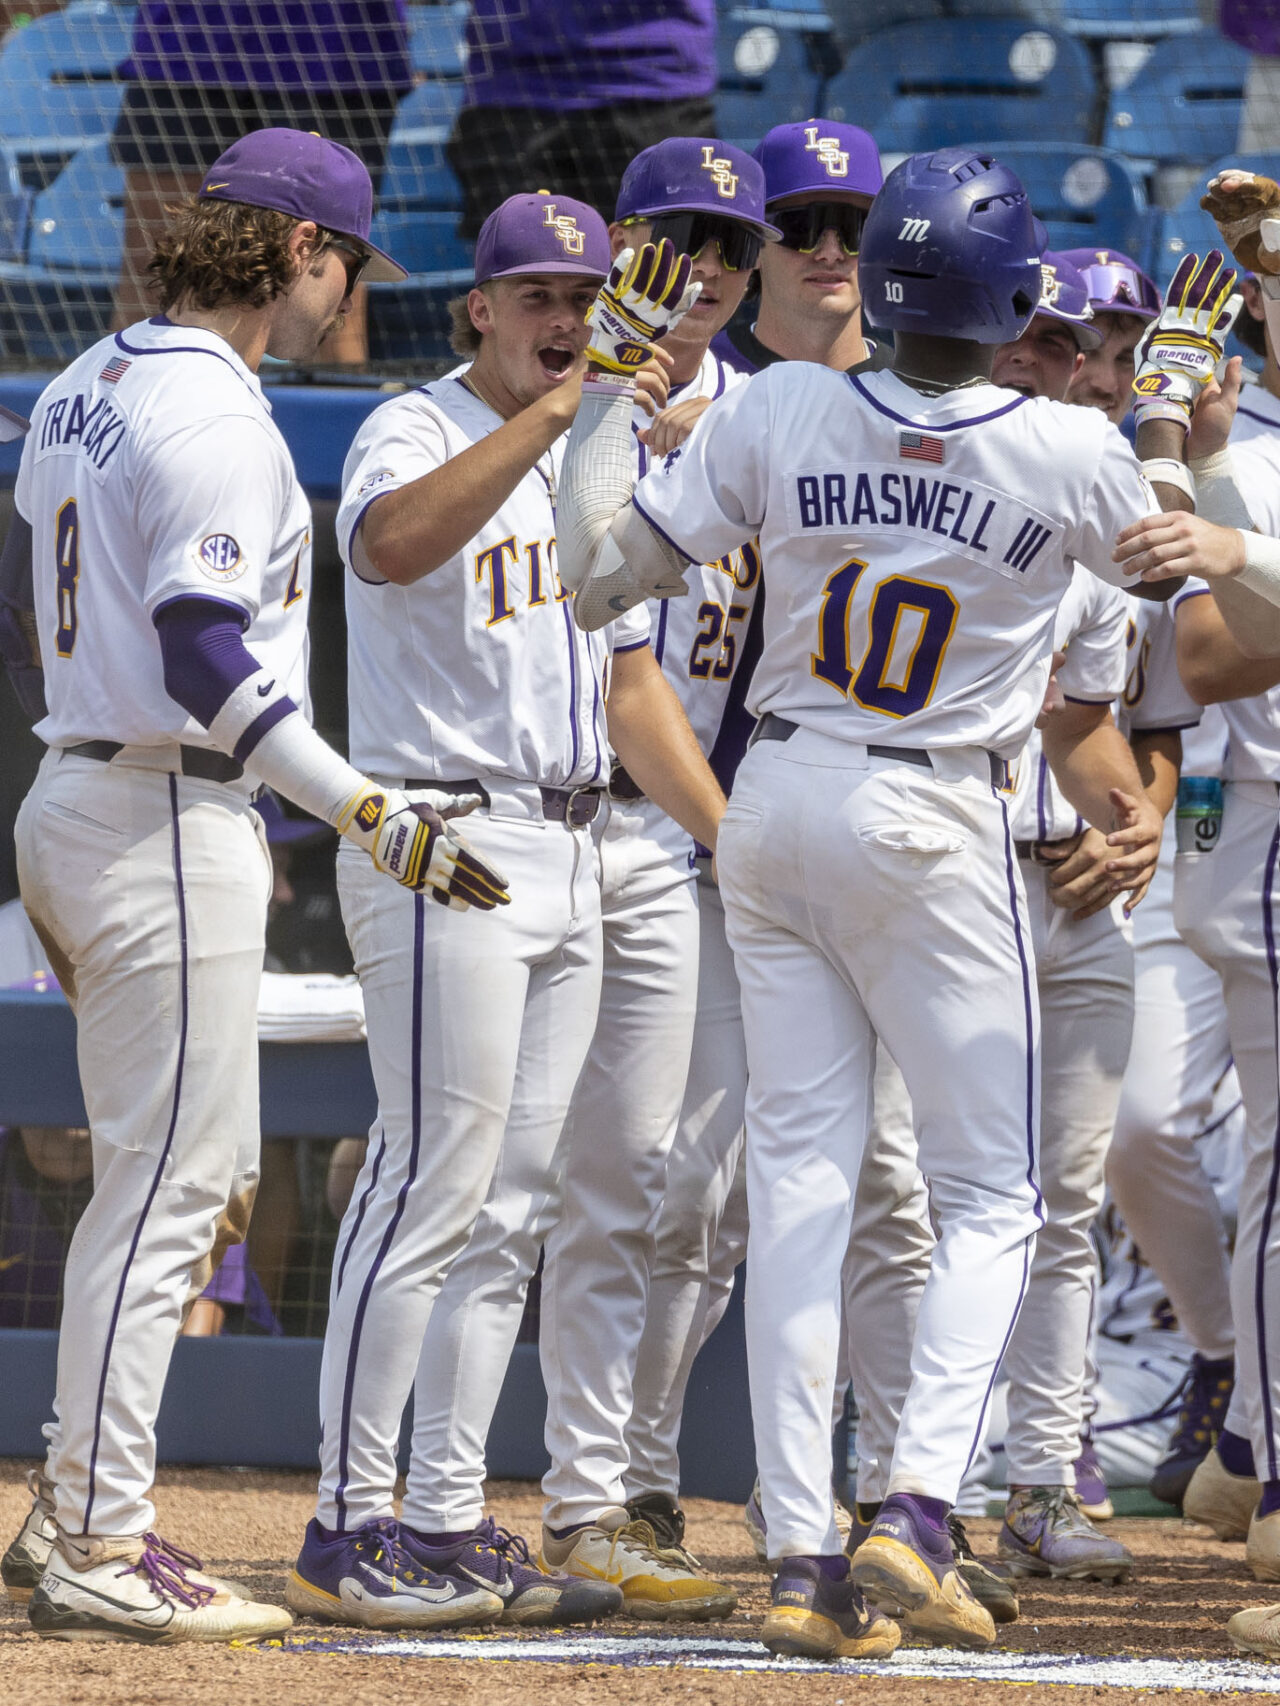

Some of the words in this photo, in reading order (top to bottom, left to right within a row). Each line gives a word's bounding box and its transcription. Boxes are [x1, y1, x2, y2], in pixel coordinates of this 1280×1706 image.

[702, 146, 738, 199] LSU
[805, 127, 849, 177] LSU
[543, 204, 586, 256] LSU
[884, 281, 903, 302] 10
[1156, 349, 1207, 365] marucci
[797, 473, 996, 552] BRASWELL
[1002, 517, 1052, 573] III
[55, 496, 80, 659] 8
[202, 536, 238, 572] SEC
[689, 601, 750, 682] 25
[811, 557, 962, 720] 10
[389, 823, 409, 874] marucci
[778, 1590, 807, 1603] TIGERS
